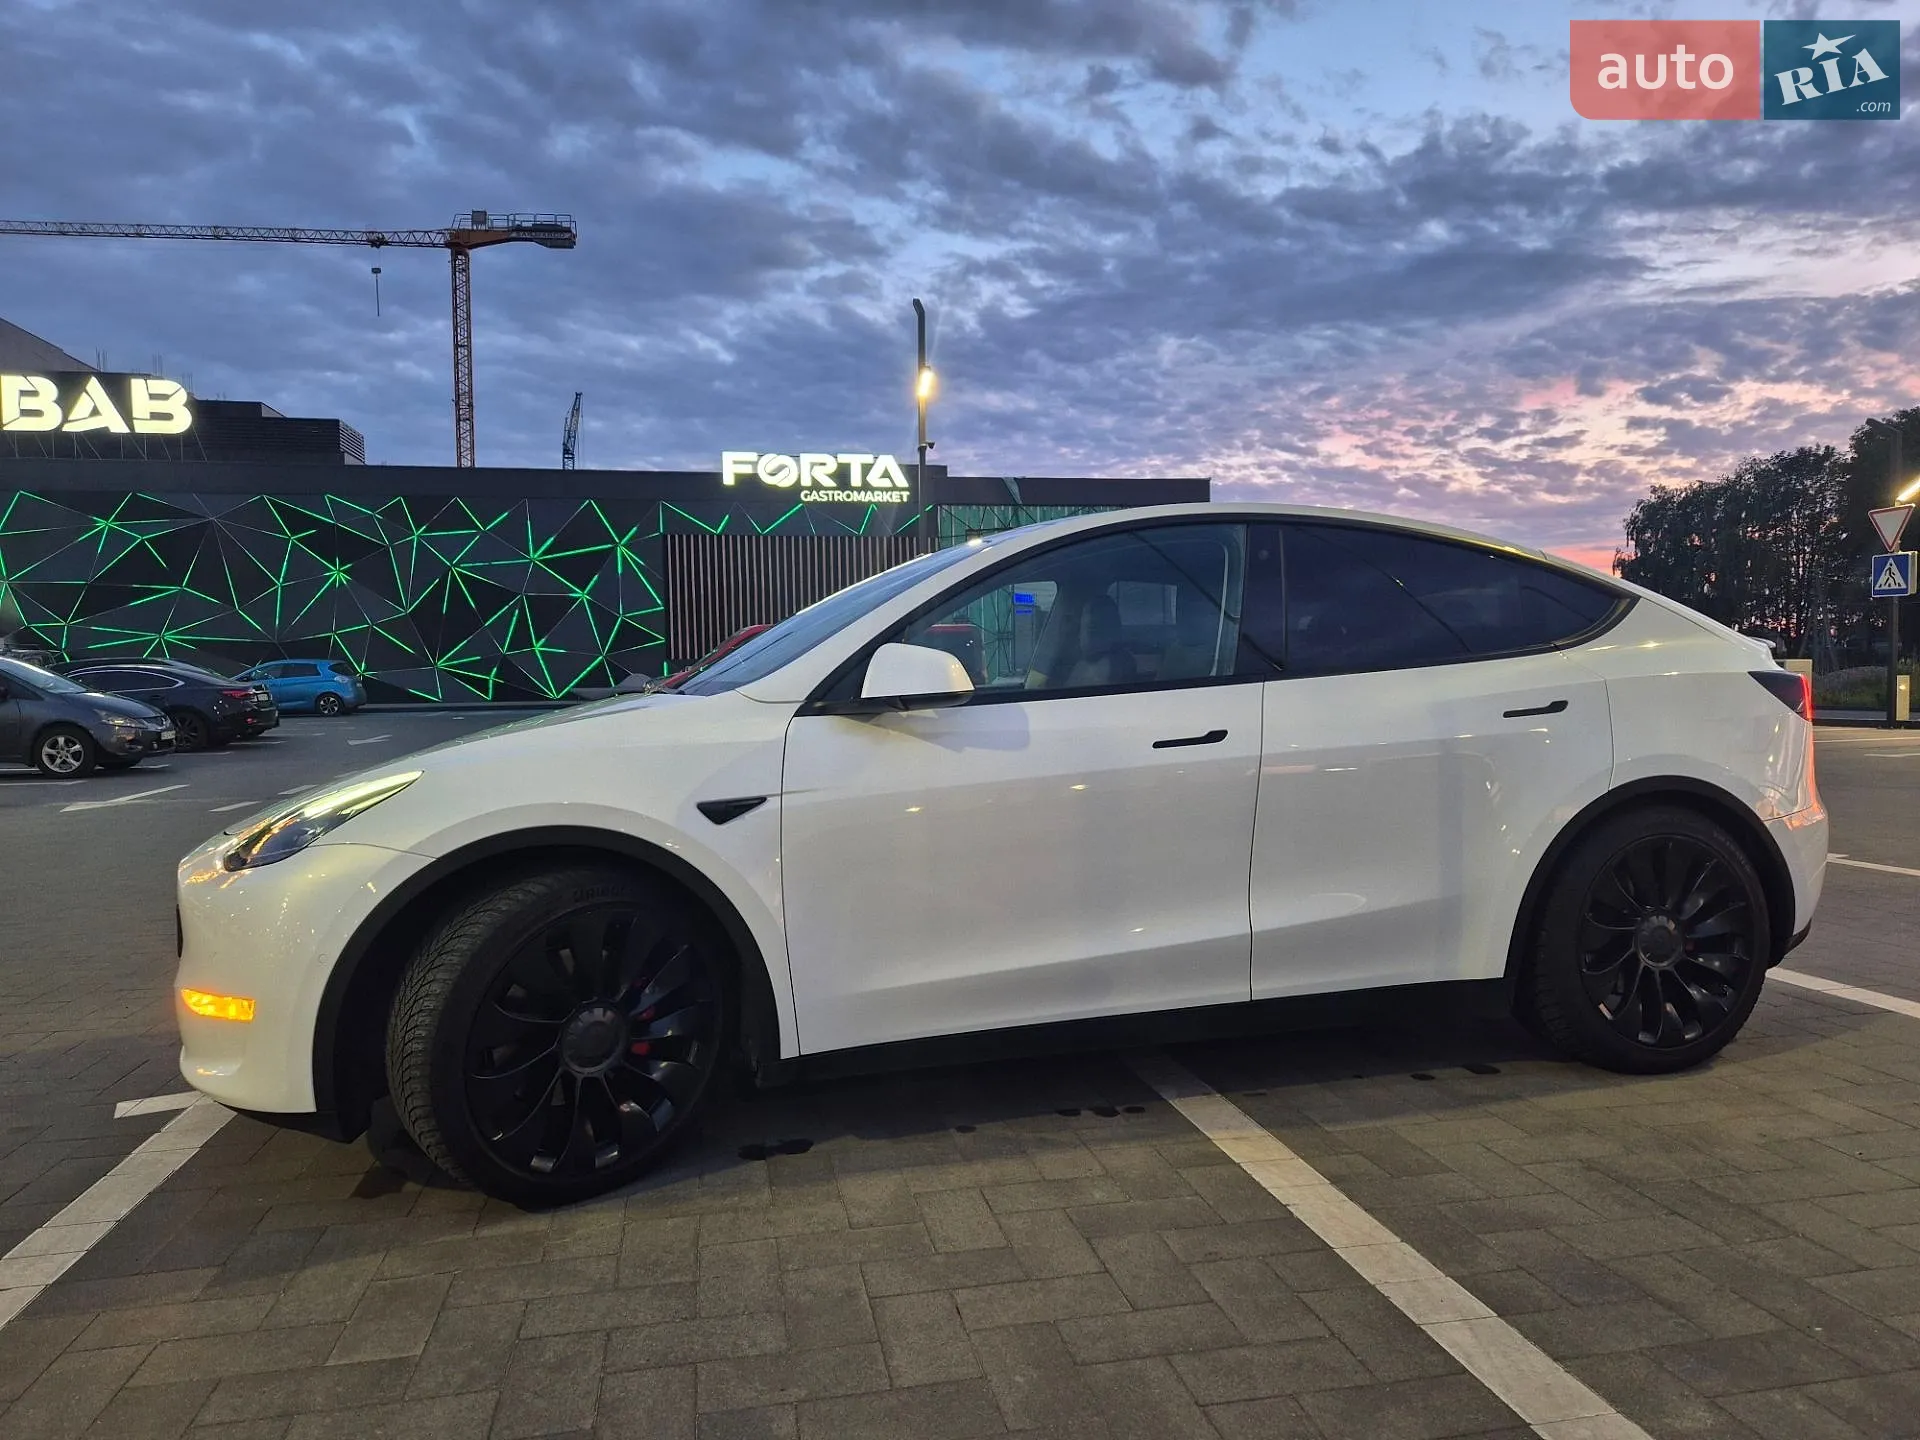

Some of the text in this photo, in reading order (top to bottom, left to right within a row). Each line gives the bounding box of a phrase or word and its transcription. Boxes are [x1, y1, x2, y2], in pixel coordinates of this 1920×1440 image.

[0, 375, 193, 434] BAB
[721, 451, 910, 488] FORTA
[800, 490, 910, 503] GASTROMARKET
